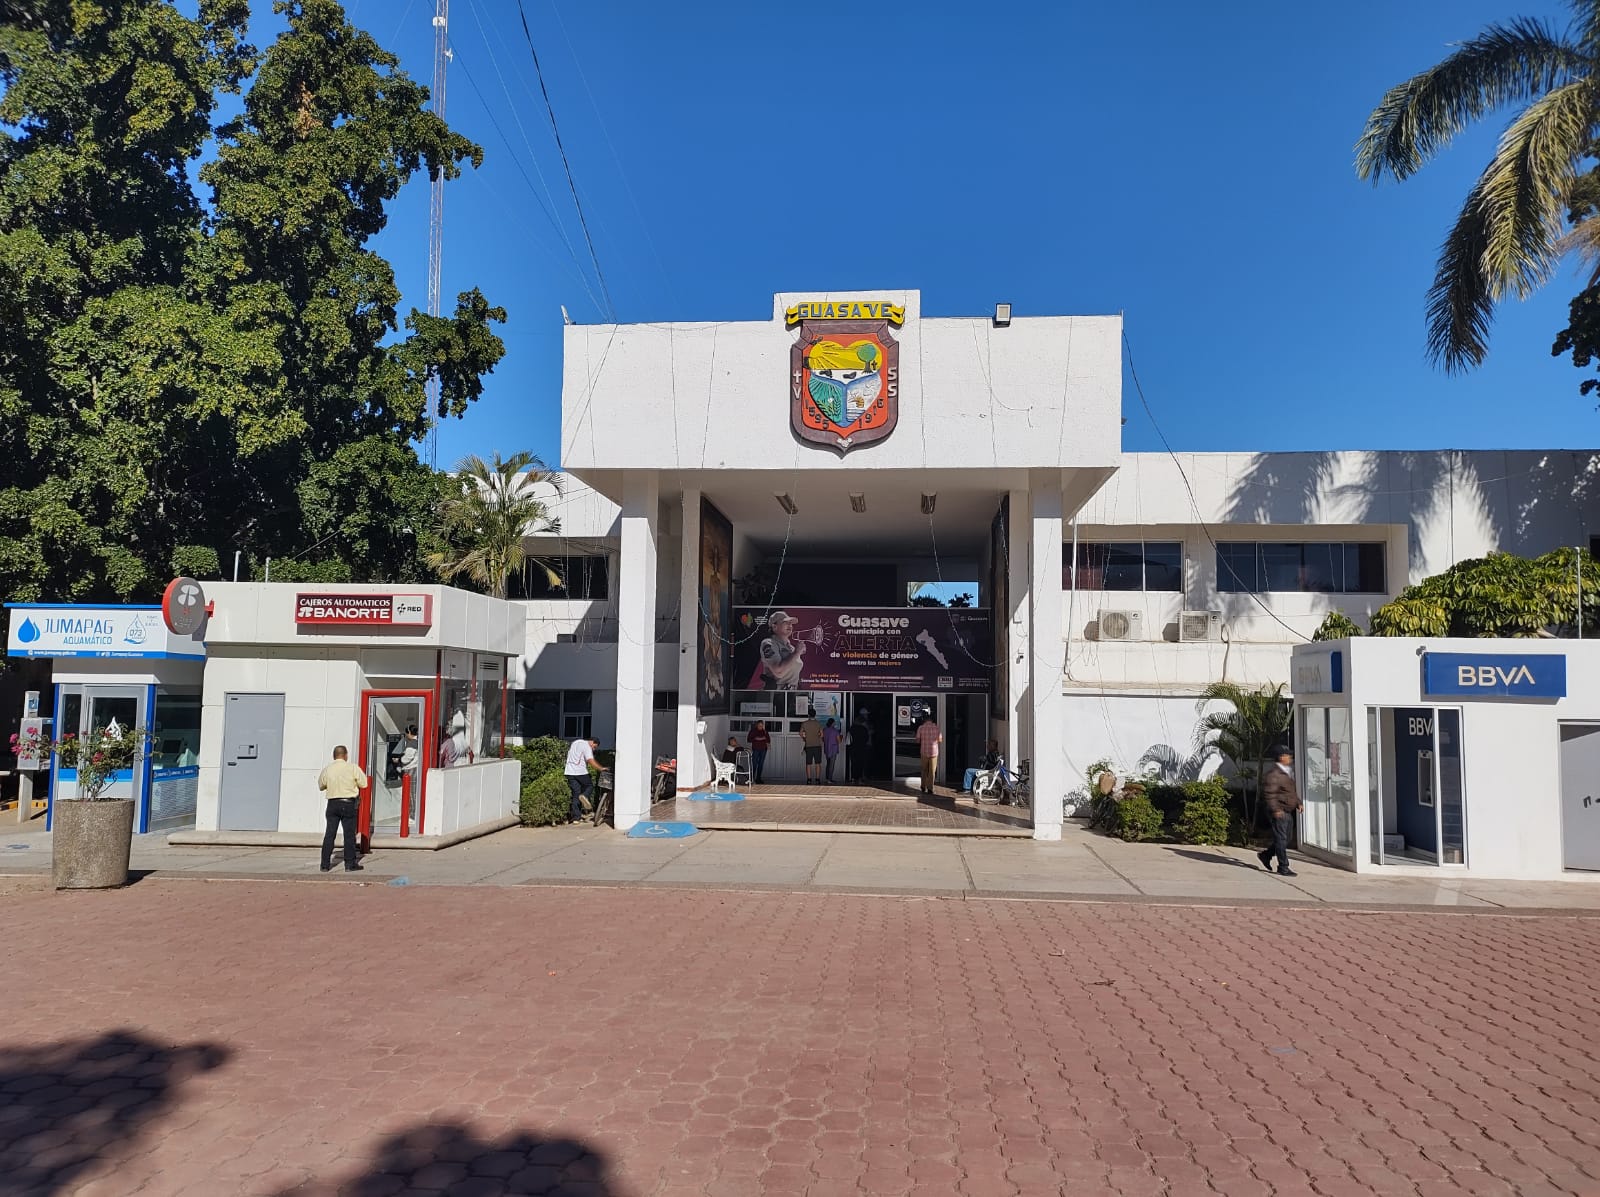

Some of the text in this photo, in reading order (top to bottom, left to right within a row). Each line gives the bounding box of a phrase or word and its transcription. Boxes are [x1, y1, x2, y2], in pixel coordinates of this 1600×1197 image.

[797, 303, 893, 318] GUASAVE
[299, 598, 391, 607] CAJEROS AUTOMATICOS
[314, 607, 390, 619] BANORTE
[43, 618, 113, 634] JUMAPAG
[838, 614, 910, 628] Guasave
[846, 628, 884, 636] municipio
[834, 635, 917, 650] ALERTA
[890, 651, 919, 659] género
[1458, 665, 1536, 687] BBVA
